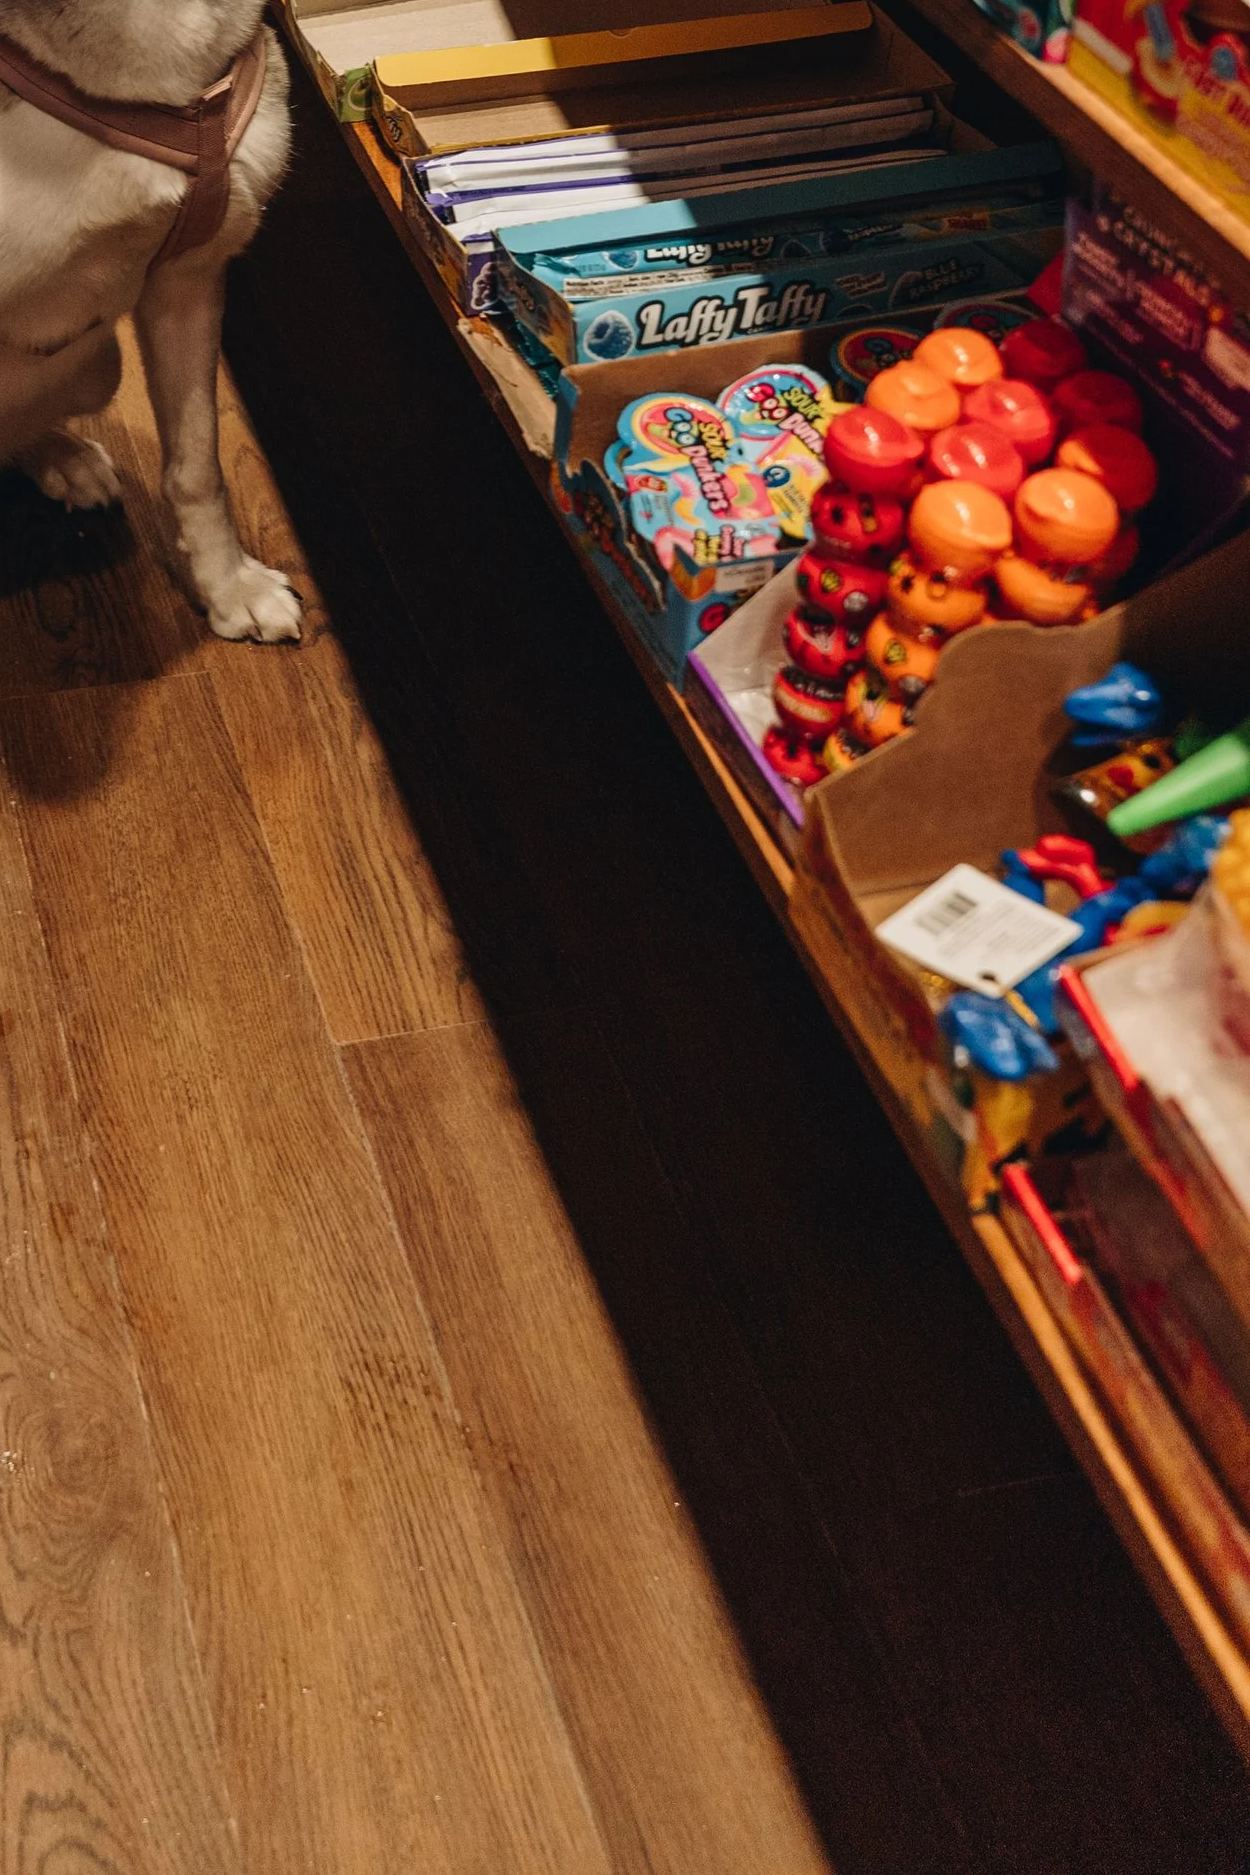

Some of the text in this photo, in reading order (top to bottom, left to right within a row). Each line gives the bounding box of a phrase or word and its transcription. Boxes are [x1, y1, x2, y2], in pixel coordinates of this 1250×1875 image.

[639, 295, 741, 347] Laffy
[737, 281, 829, 336] Taffy
[783, 387, 826, 422] SOUR
[698, 420, 730, 463] SOUR
